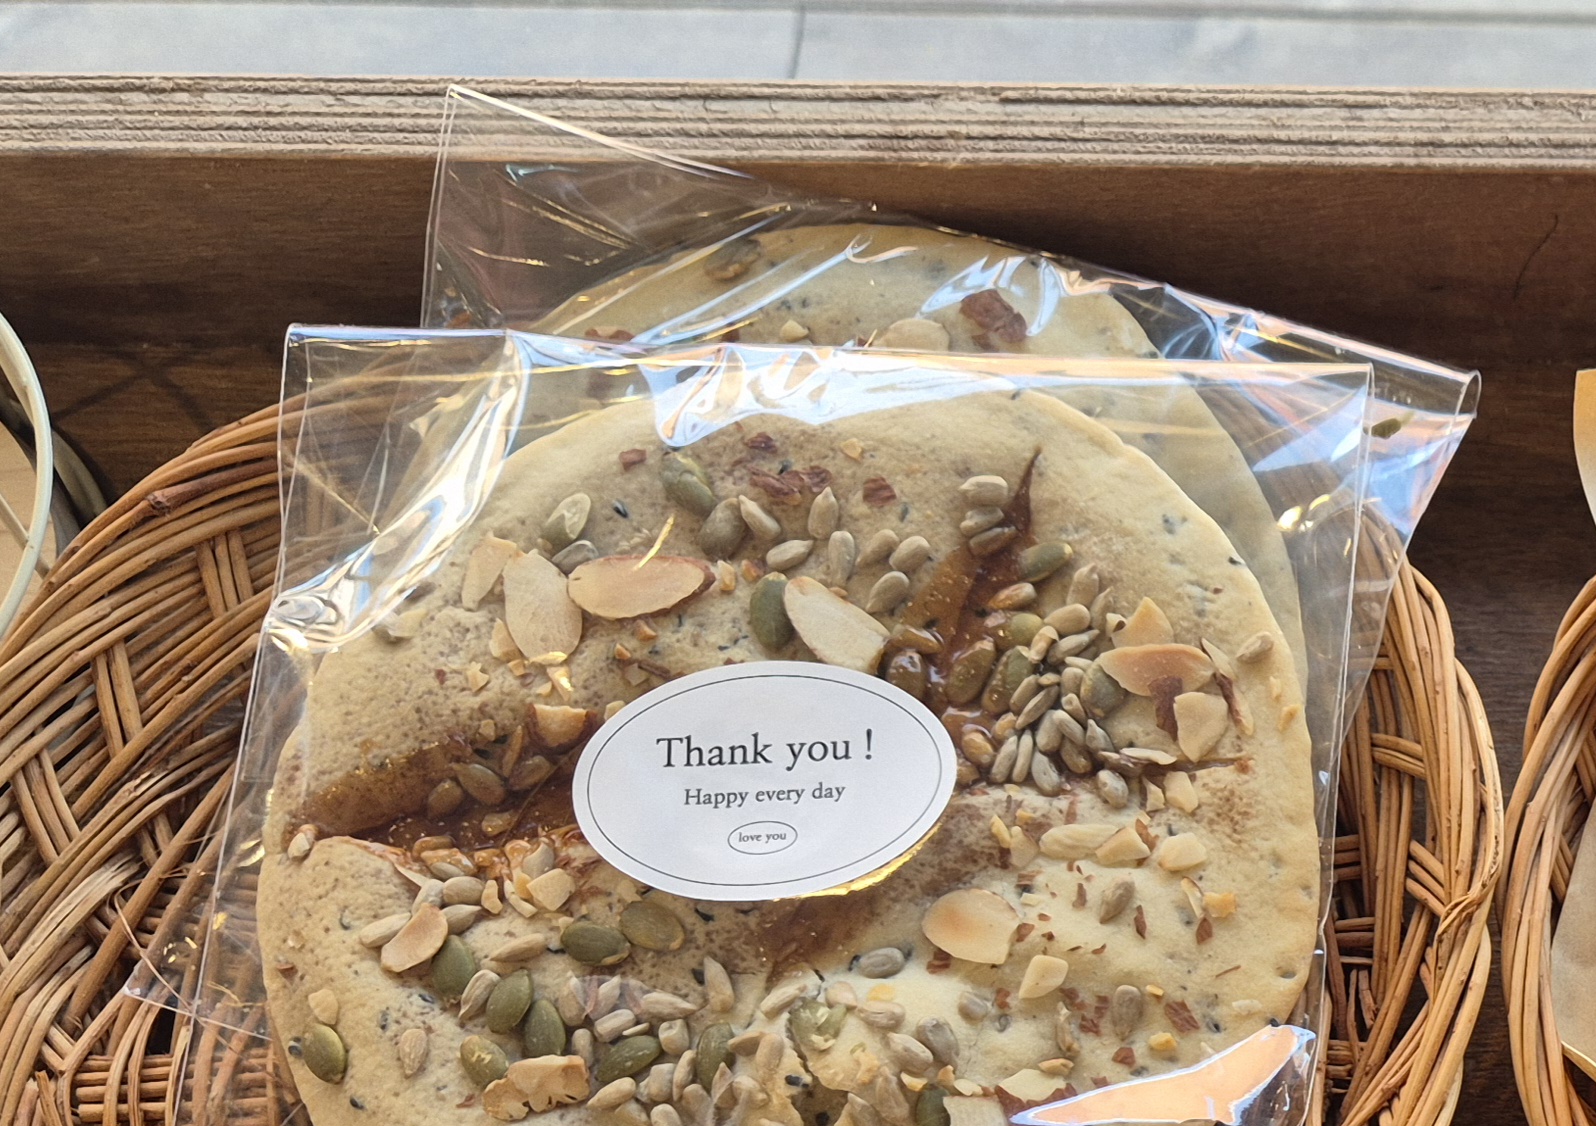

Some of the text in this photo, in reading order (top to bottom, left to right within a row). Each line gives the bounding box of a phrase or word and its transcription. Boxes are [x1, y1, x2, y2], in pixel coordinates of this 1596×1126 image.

[655, 733, 773, 768] Thank
[785, 739, 853, 772] you
[684, 781, 846, 809] Happy every day
[737, 830, 788, 845] love you
